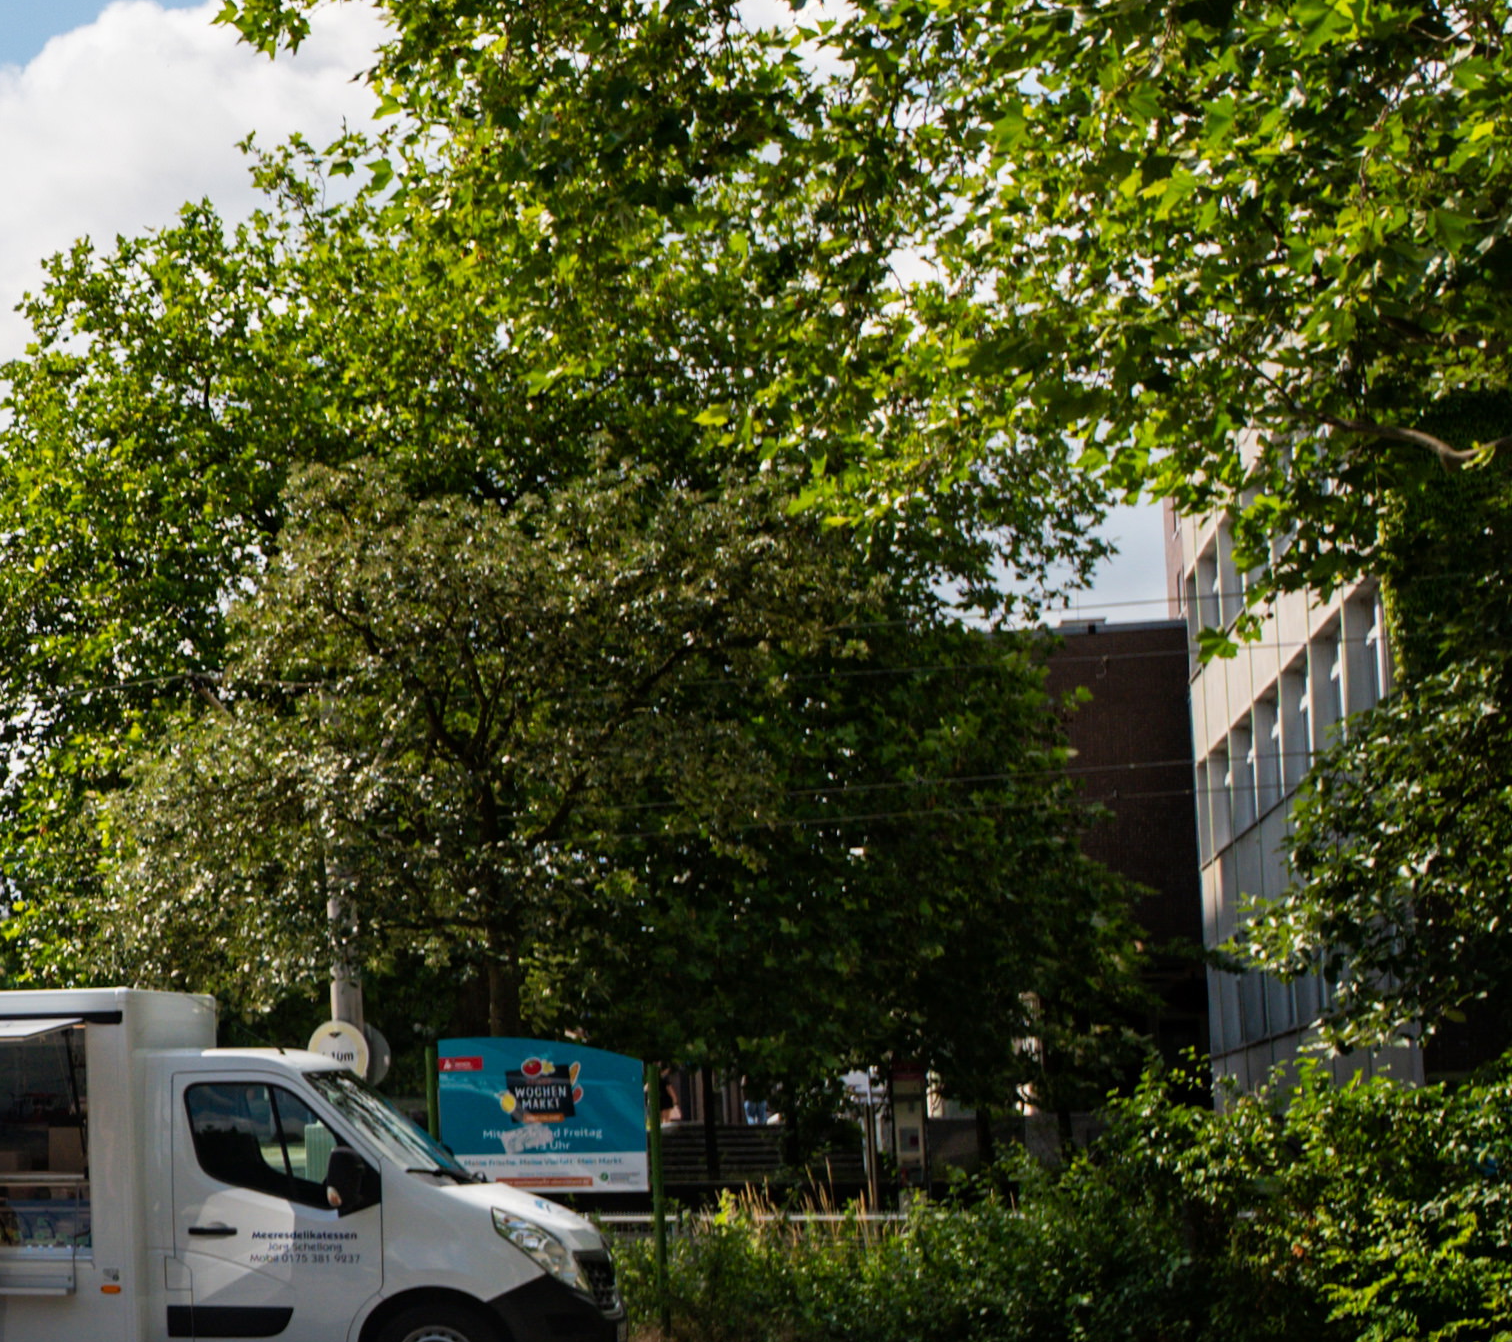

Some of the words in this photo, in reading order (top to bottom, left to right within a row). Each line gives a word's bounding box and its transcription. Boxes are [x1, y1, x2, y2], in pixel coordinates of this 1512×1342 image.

[514, 1085, 567, 1098] WOCHEN
[521, 1098, 561, 1110] MARKT
[564, 1128, 603, 1139] Freitag
[550, 1140, 570, 1150] Uhr
[251, 1230, 358, 1240] Meeresdelikatessen
[268, 1242, 289, 1252] Jörg
[250, 1253, 279, 1263] Mobil
[282, 1253, 308, 1263] 0175
